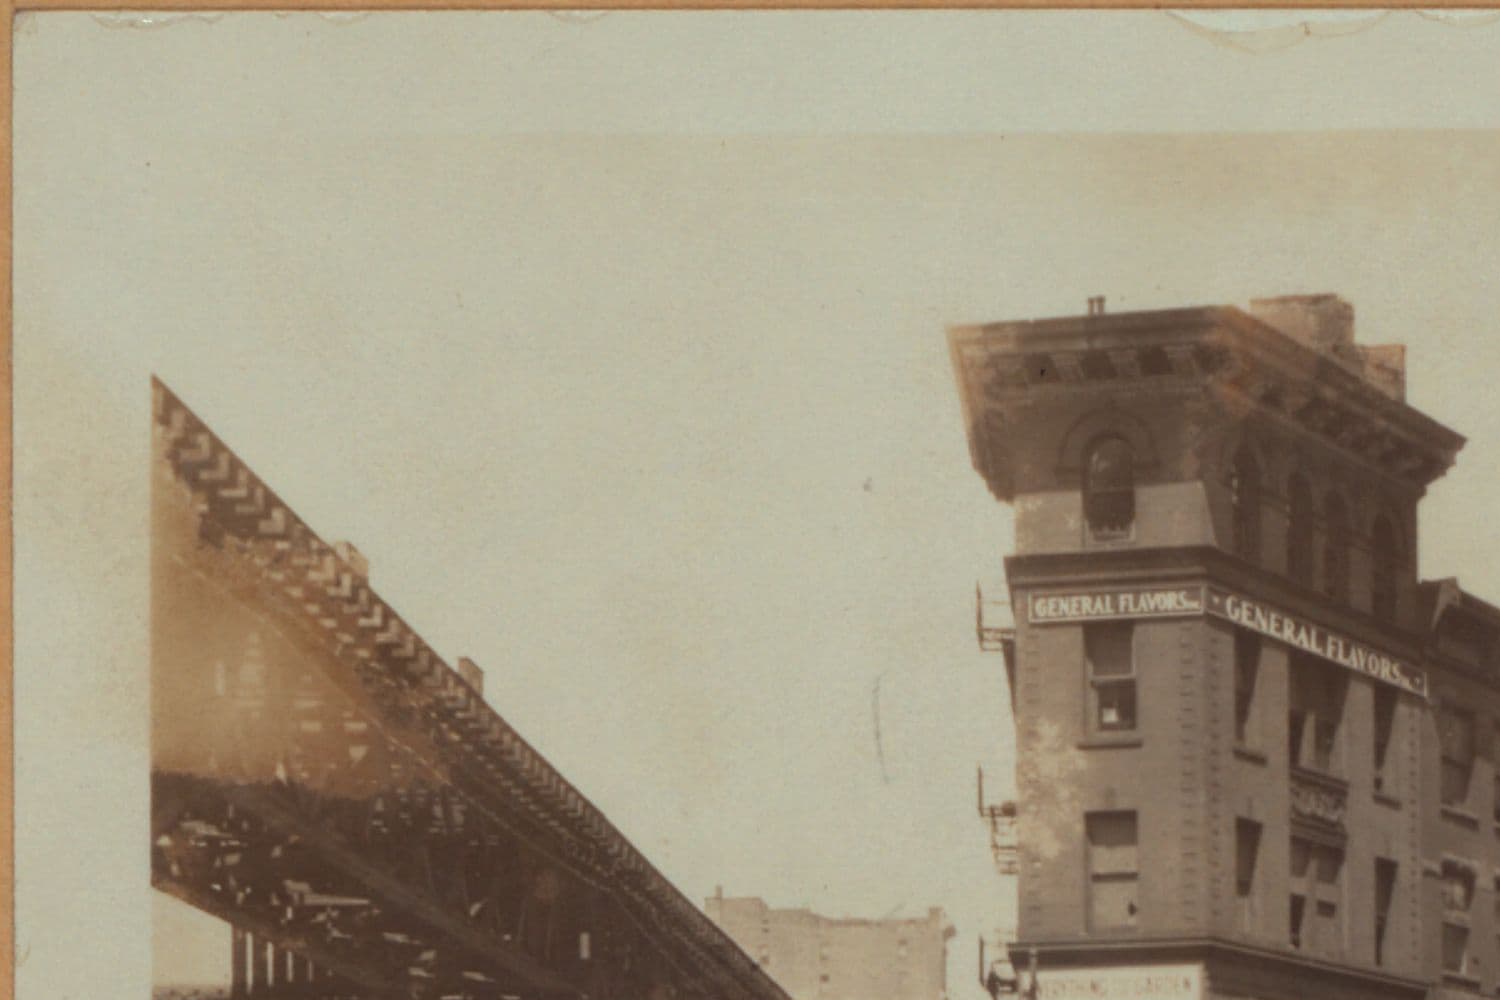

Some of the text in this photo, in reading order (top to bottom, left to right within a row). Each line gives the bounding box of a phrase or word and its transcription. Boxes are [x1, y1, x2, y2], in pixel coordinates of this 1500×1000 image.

[1035, 594, 1113, 618] GENERAL
[1118, 591, 1186, 614] FLAVORS
[1225, 594, 1401, 681] GENERAL FLAVORS
